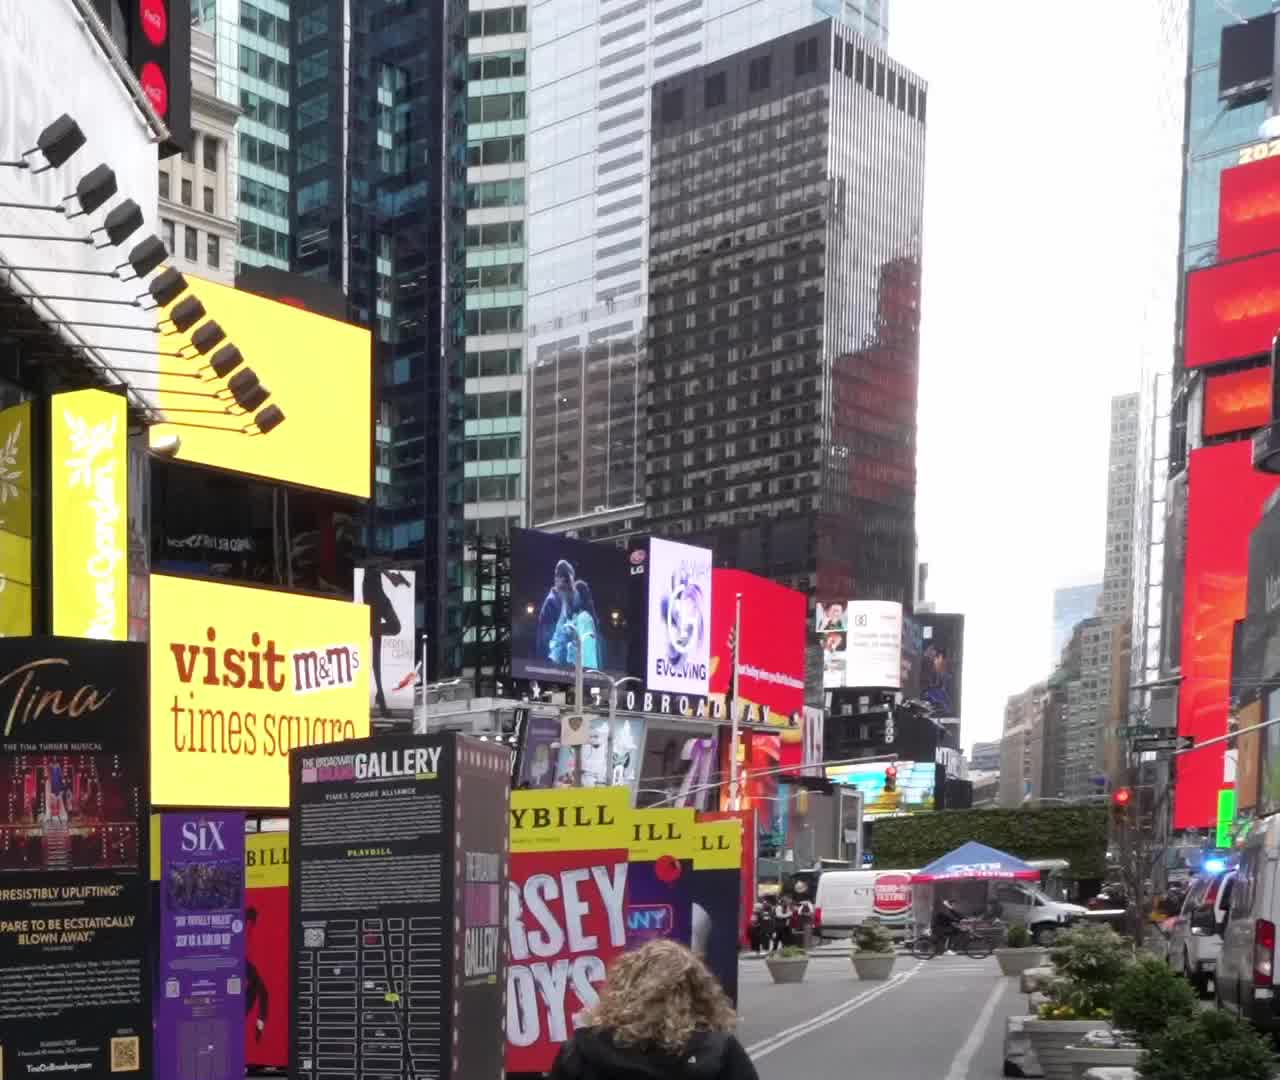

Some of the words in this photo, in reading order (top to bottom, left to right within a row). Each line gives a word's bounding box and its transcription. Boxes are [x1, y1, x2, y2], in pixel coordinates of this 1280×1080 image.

[630, 566, 644, 575] LG
[170, 626, 285, 691] visit
[170, 691, 256, 755] times
[643, 692, 771, 723] BROADAY
[354, 746, 441, 779] GALLERY
[511, 804, 614, 829] YBILL
[31, 919, 45, 930] TO
[48, 919, 61, 929] BE
[64, 916, 135, 928] ECSTATICALLY
[509, 862, 628, 960] RSEY
[18, 932, 57, 944] BLOWN
[506, 955, 606, 1046] OYS
